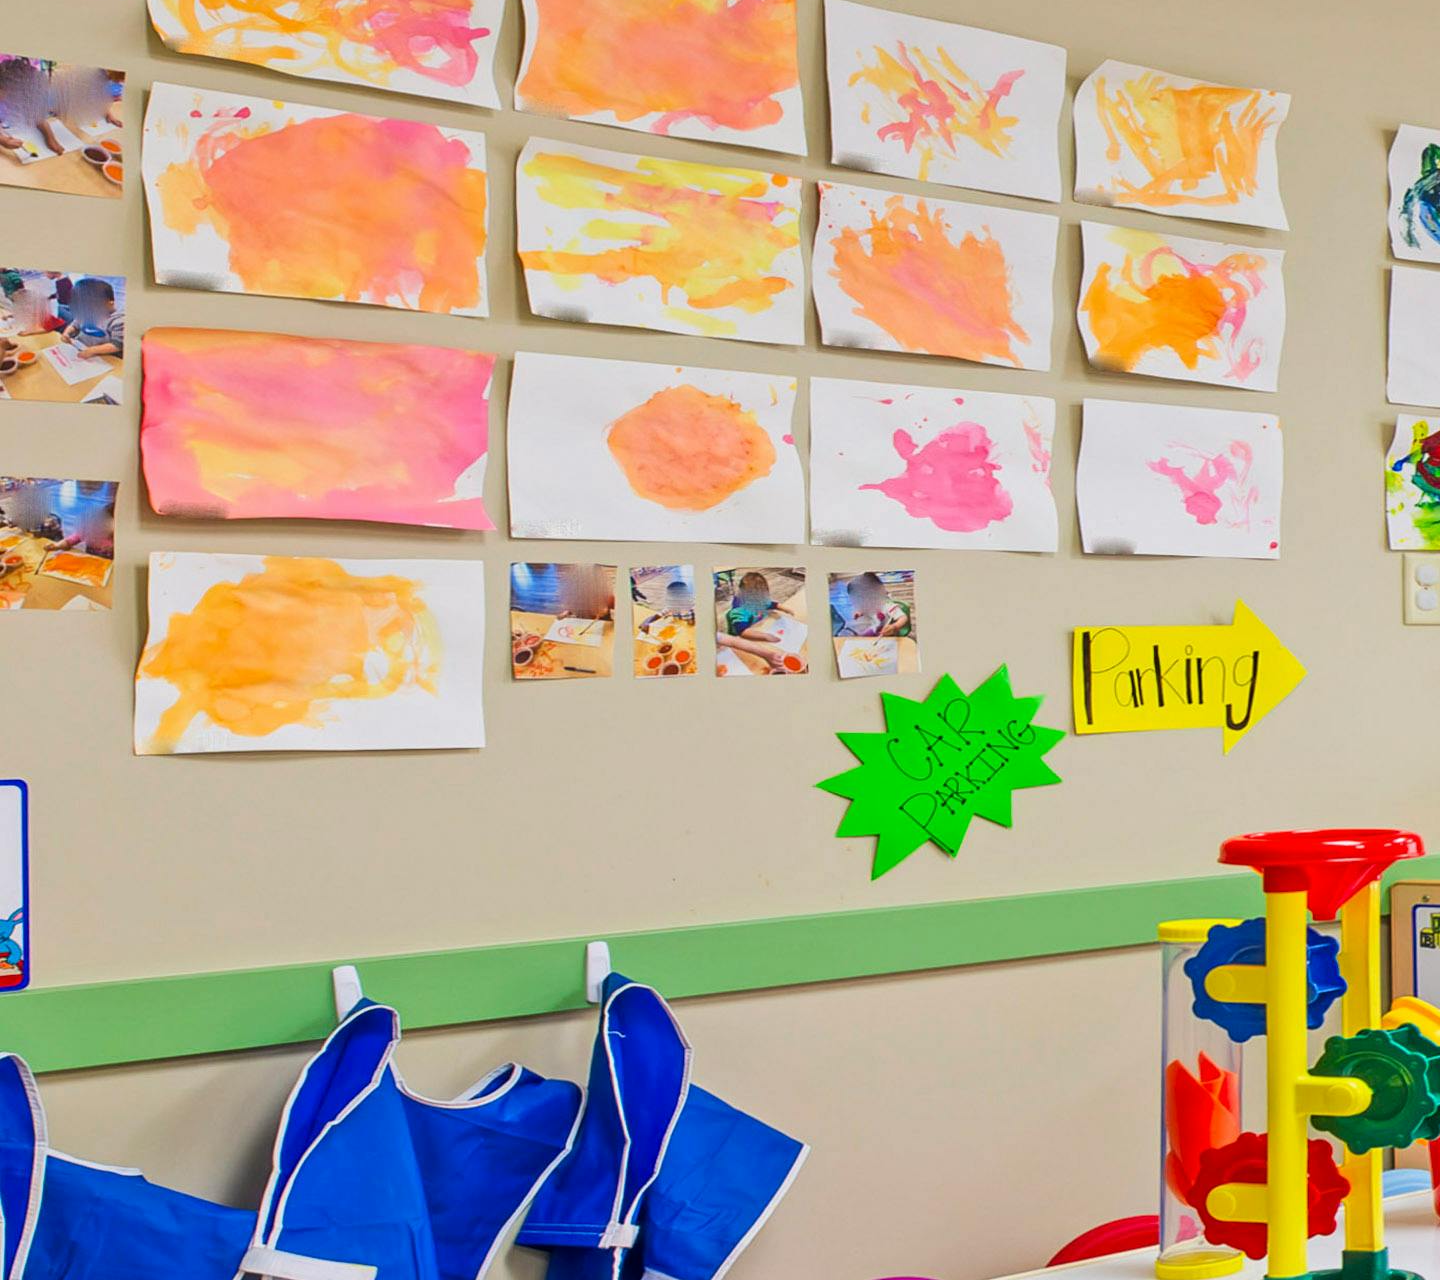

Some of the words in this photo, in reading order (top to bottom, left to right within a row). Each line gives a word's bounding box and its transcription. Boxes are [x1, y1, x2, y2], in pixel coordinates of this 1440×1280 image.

[1082, 628, 1260, 732] Parking
[886, 698, 986, 781] CAR
[899, 719, 1037, 854] PARKING
